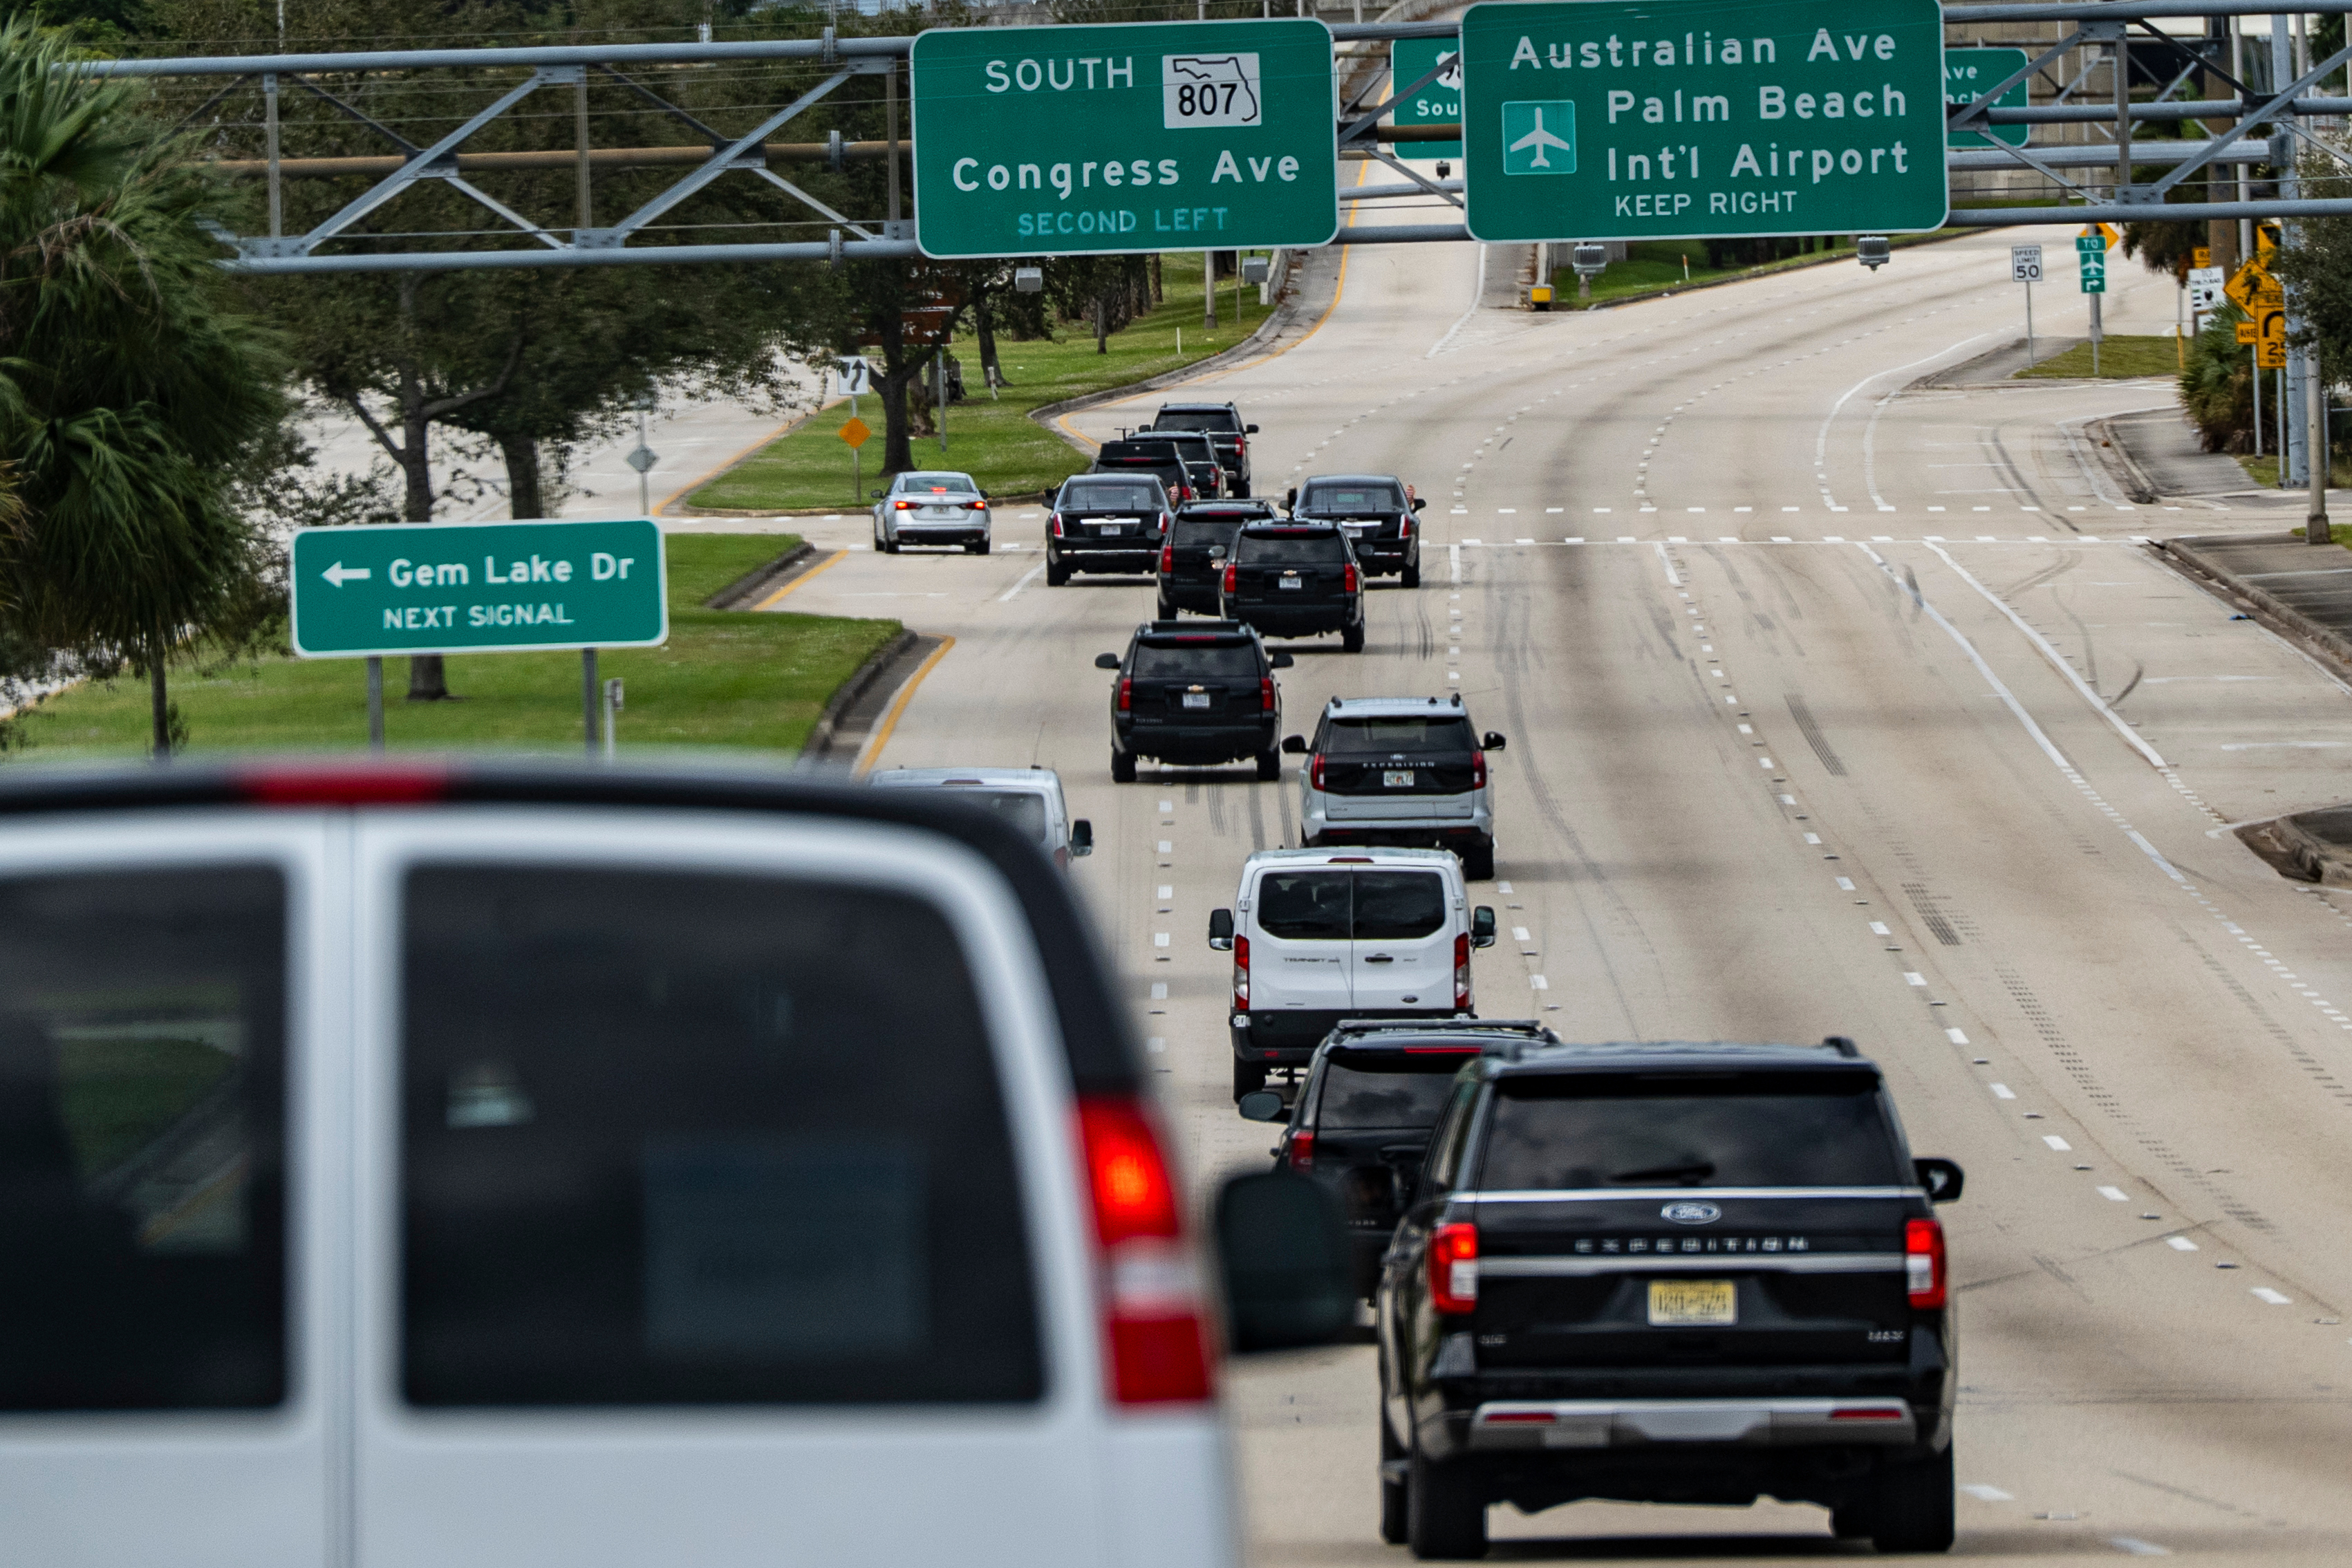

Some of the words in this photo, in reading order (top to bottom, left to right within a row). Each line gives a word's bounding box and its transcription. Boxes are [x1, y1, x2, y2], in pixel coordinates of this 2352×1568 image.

[1510, 30, 1776, 71] Australian
[1807, 27, 1896, 62] Ave
[984, 57, 1133, 93] SOUTH
[1179, 83, 1238, 116] 807
[1607, 89, 1730, 124] Palm
[1759, 84, 1907, 120] Beach
[952, 157, 1180, 200] Congress
[1211, 149, 1300, 184] Ave
[1607, 144, 1700, 182] Int'l
[1730, 141, 1909, 185] Airport
[1614, 193, 1692, 217] KEEP
[1709, 190, 1798, 215] RIGHT
[1018, 209, 1137, 236] SECOND
[1155, 207, 1228, 231] LEFT
[2017, 264, 2040, 279] 50
[389, 557, 469, 588] Gem
[485, 554, 573, 584] Lake
[591, 552, 635, 581] Dr
[383, 606, 457, 630] NEXT
[468, 602, 575, 627] SIGNAL
[1574, 1236, 1809, 1253] EXPEDITION
